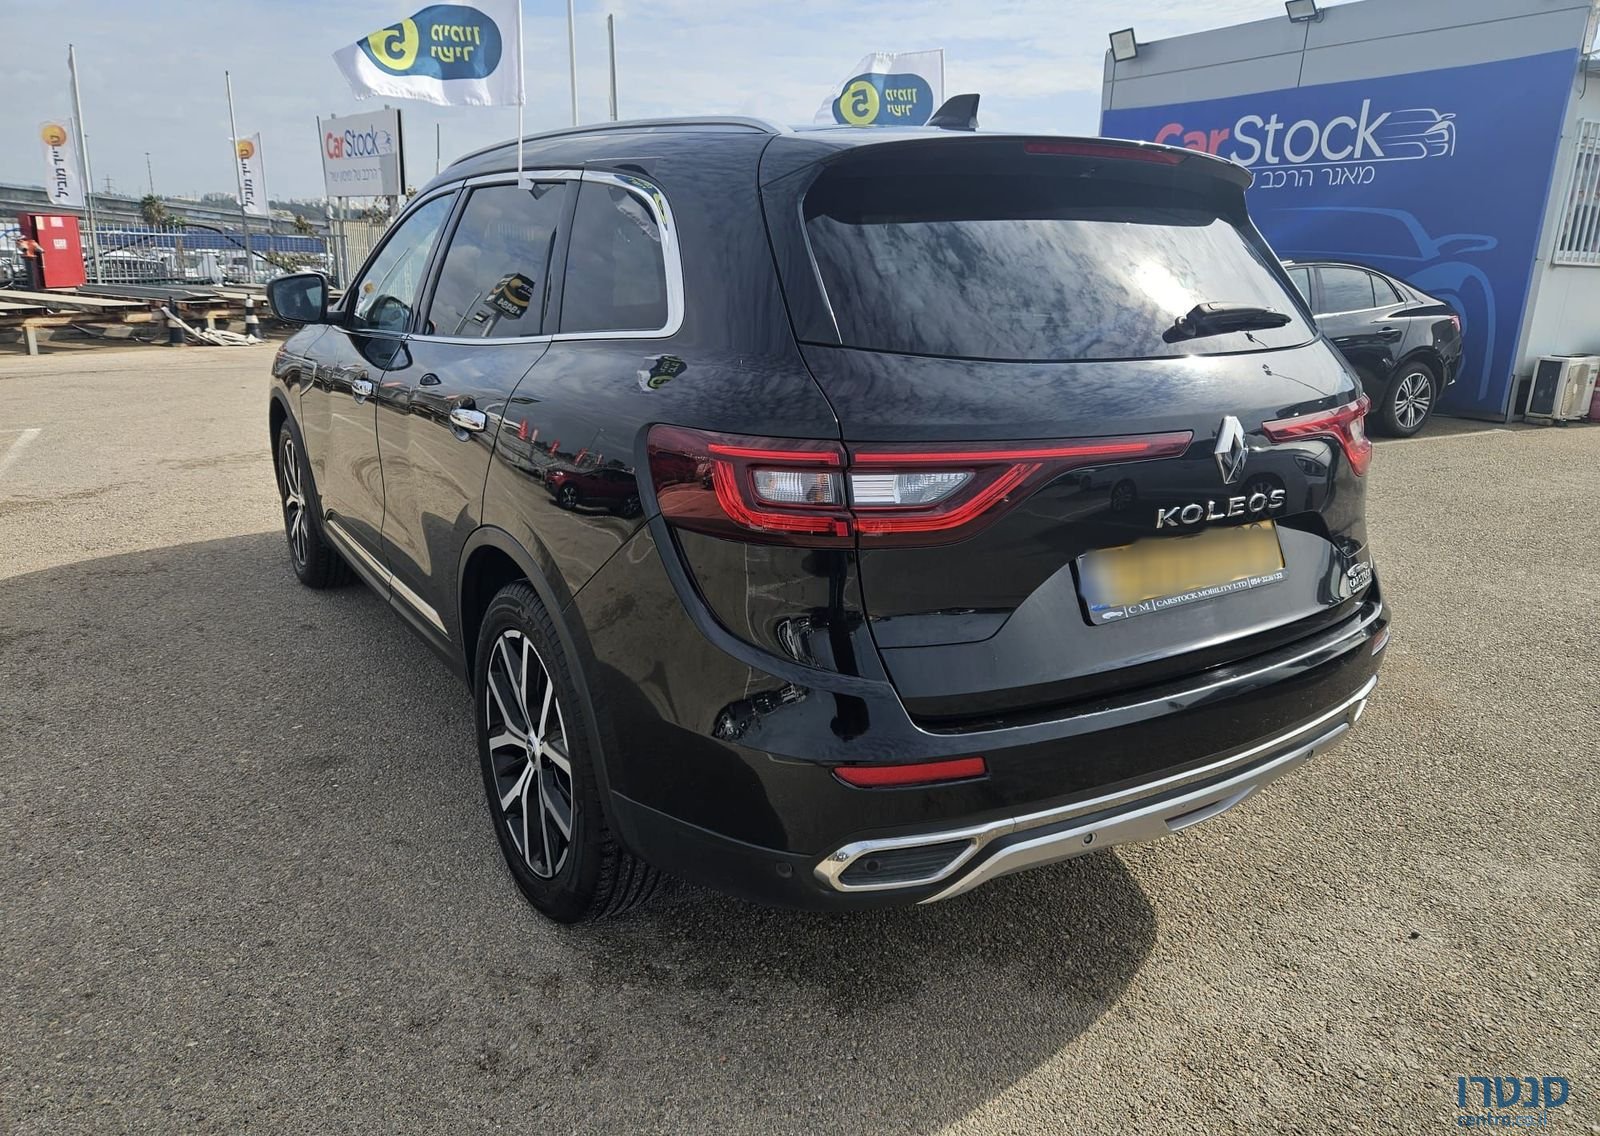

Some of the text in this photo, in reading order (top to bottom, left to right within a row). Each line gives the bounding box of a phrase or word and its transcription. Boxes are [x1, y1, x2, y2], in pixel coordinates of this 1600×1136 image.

[326, 123, 379, 159] CarStock
[1260, 169, 1314, 189] הרכב
[1321, 165, 1376, 186] מאגר
[1156, 488, 1287, 529] KOLEOS
[1156, 592, 1198, 608] CARSTOCK
[1198, 584, 1233, 598] MOBILITY
[1232, 580, 1248, 590] LTD
